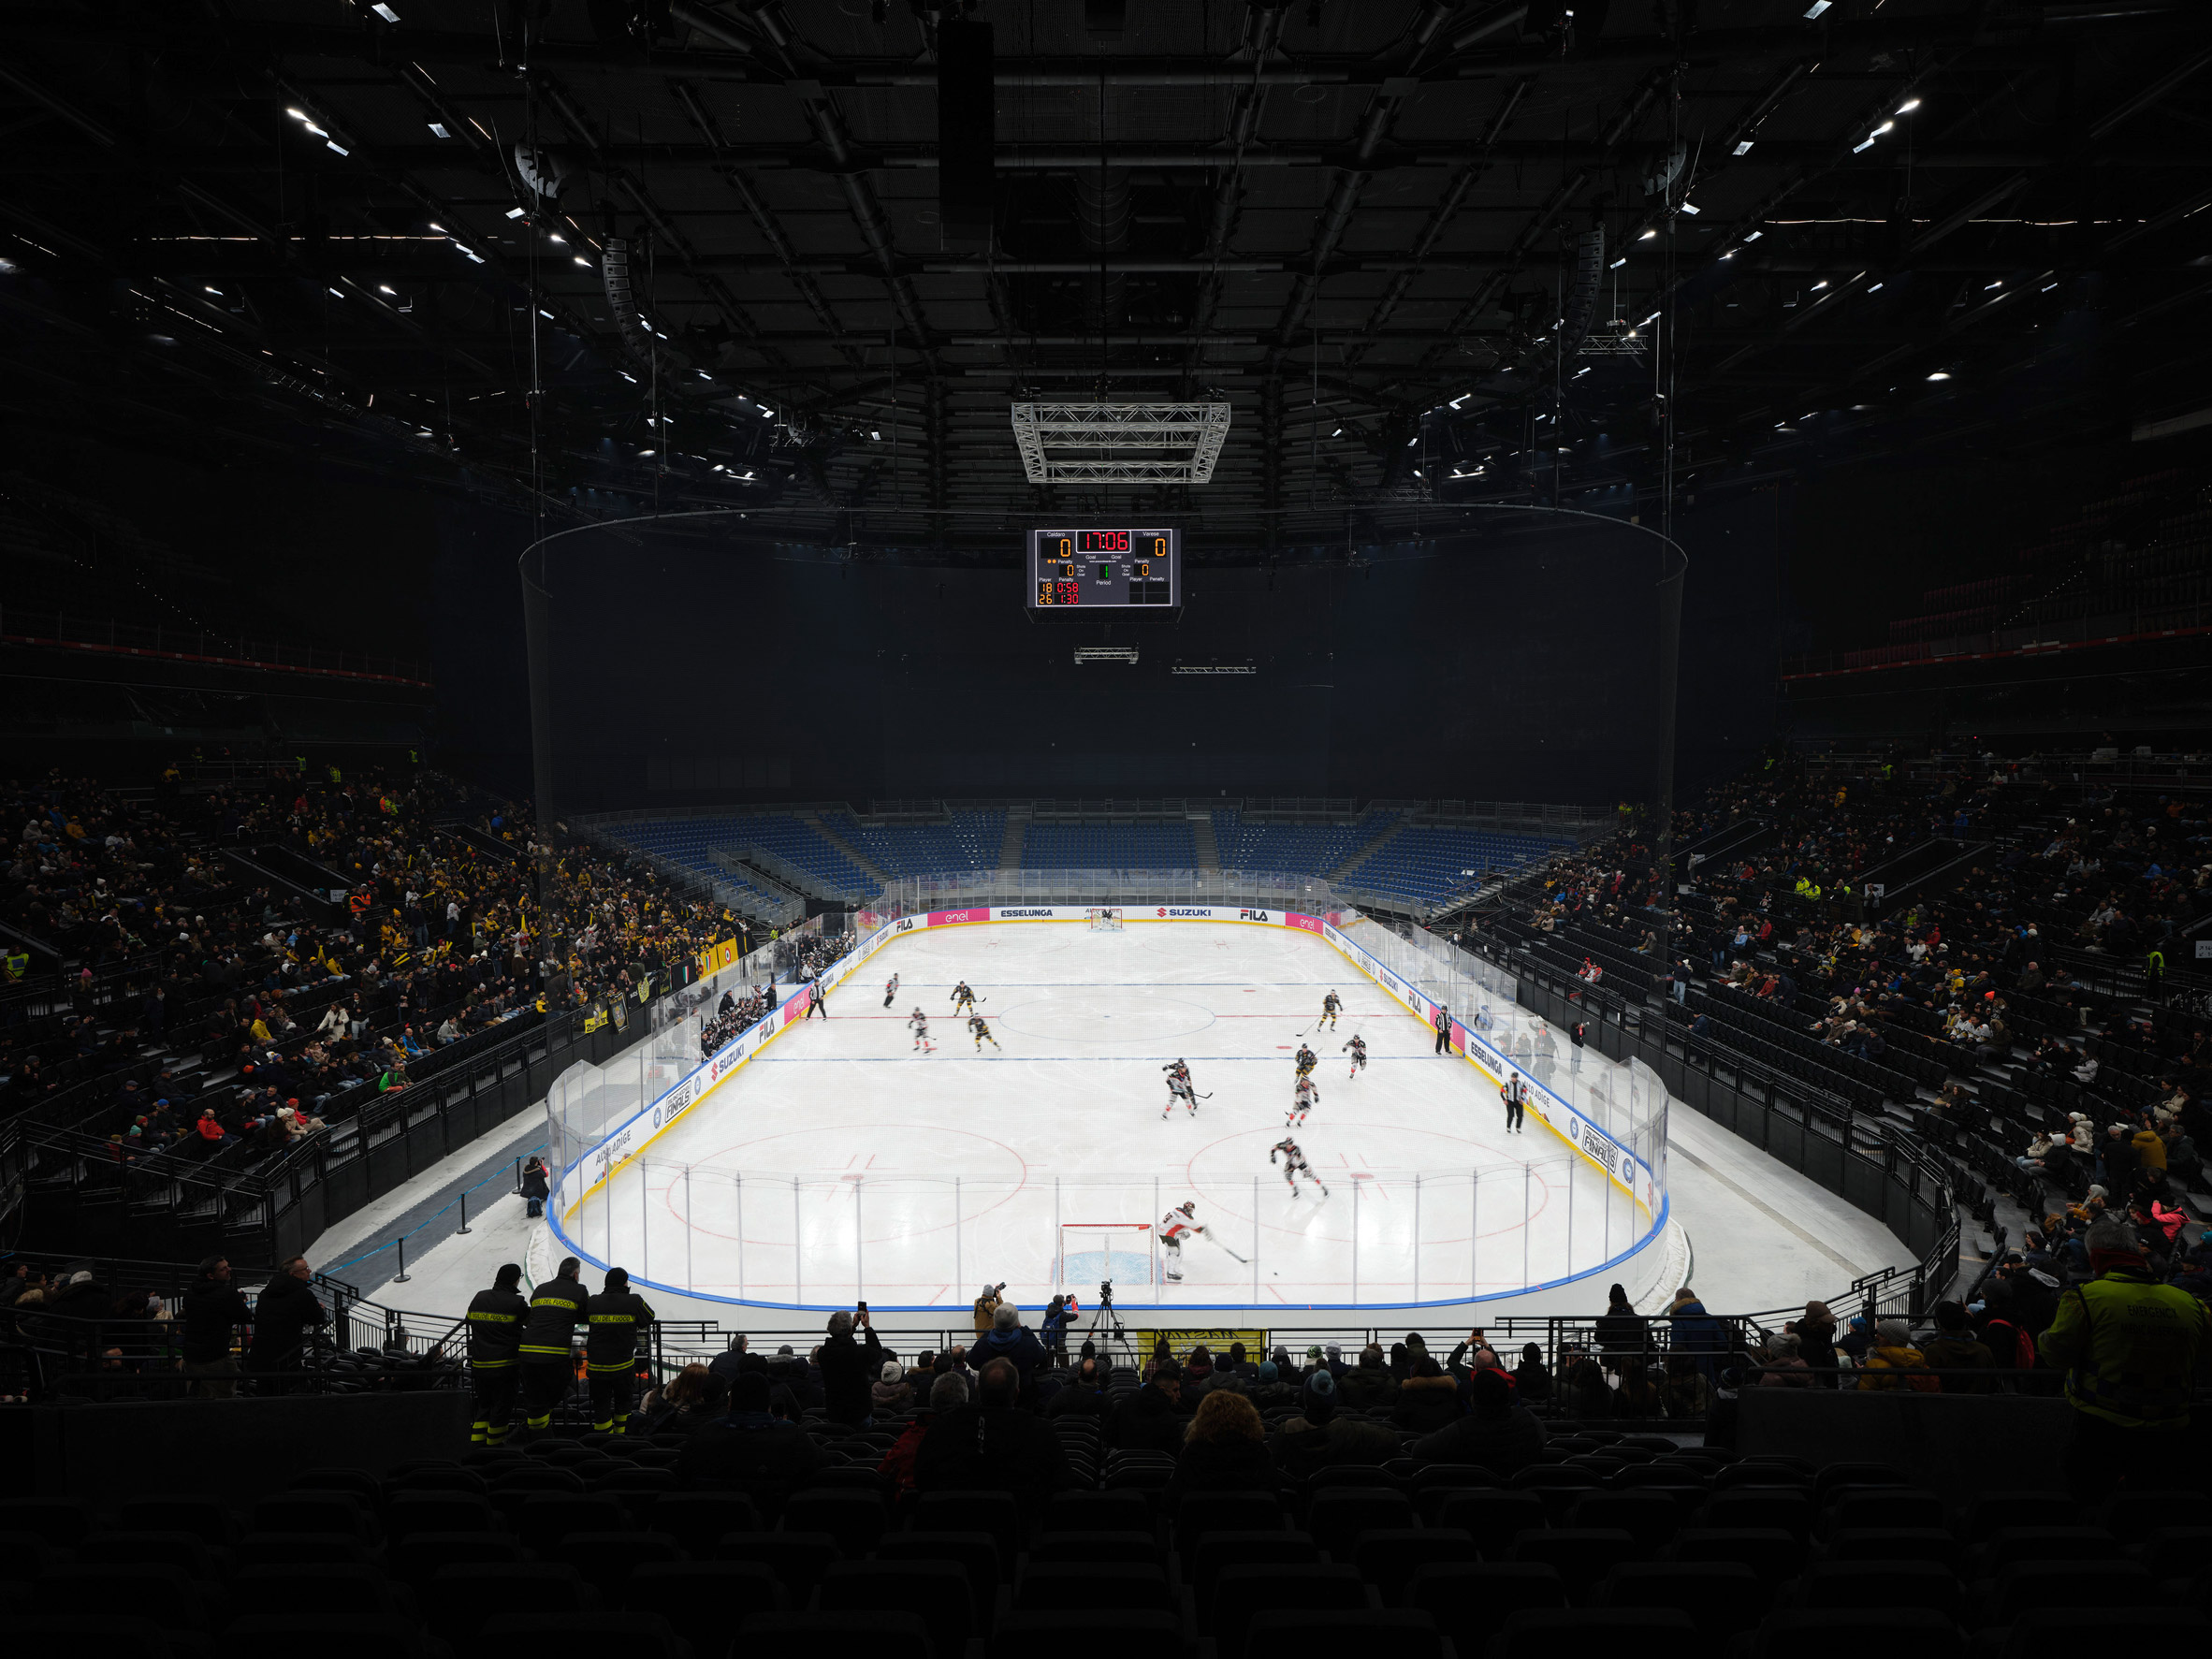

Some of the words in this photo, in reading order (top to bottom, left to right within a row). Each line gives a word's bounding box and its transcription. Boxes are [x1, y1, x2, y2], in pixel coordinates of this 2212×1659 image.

[1086, 531, 1128, 551] 17:06
[1155, 538, 1166, 557] 0
[1060, 538, 1071, 558] 0
[1067, 564, 1074, 576] 0
[1105, 565, 1109, 578] 1
[1142, 563, 1149, 575] 0
[1042, 582, 1053, 593] 18
[1056, 582, 1079, 593] 0:58
[1039, 594, 1053, 604] 26
[1060, 594, 1079, 604] 1:30
[945, 910, 969, 923] enel
[1000, 909, 1054, 917] ESSELUNGA
[1169, 909, 1212, 917] SUZUKI
[1240, 909, 1269, 922] FILA
[896, 918, 913, 933] FILA
[1300, 919, 1316, 930] enel
[1384, 973, 1399, 993] SUZUKI
[793, 997, 805, 1014] enel
[1408, 989, 1422, 1013] FILA
[759, 1017, 775, 1044] FILA
[719, 1043, 745, 1073] SUZUKI
[1471, 1041, 1503, 1077] ESSELUNGA
[667, 1090, 690, 1118] FINALS
[1584, 1135, 1616, 1169] FINALS
[553, 1299, 572, 1307] FUOCO
[2127, 1304, 2177, 1318] EMERGENCY
